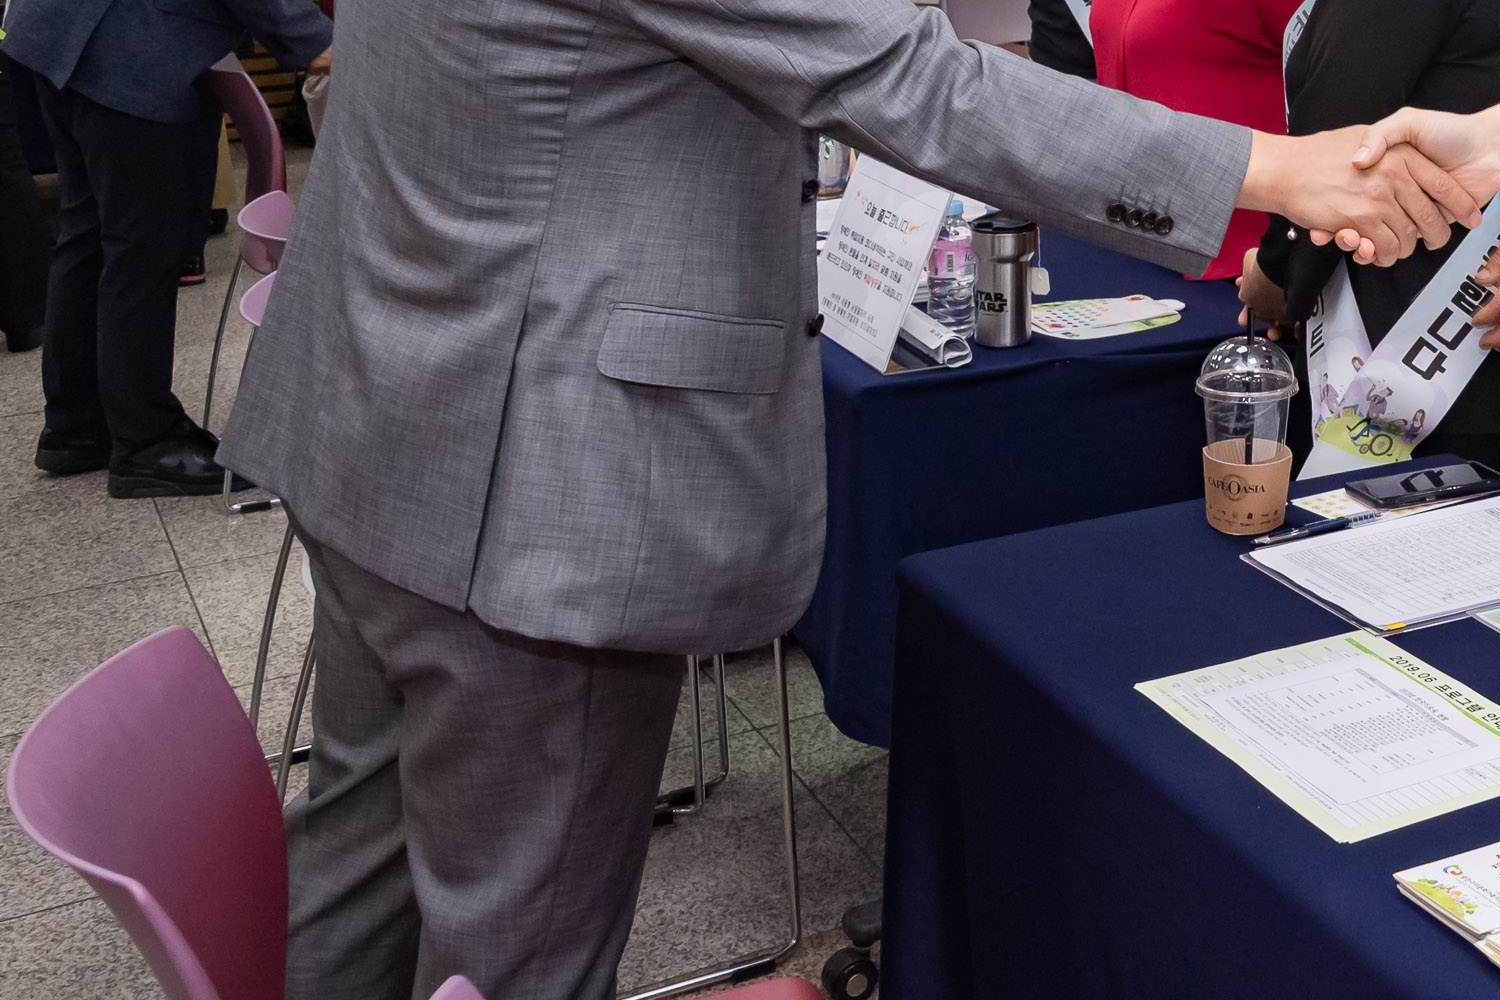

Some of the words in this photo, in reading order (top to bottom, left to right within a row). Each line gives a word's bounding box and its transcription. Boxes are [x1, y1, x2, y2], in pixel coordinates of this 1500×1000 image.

[864, 201, 878, 219] 오늘
[1389, 655, 1438, 684] 2019.06
[1434, 683, 1484, 713] 프로그램
